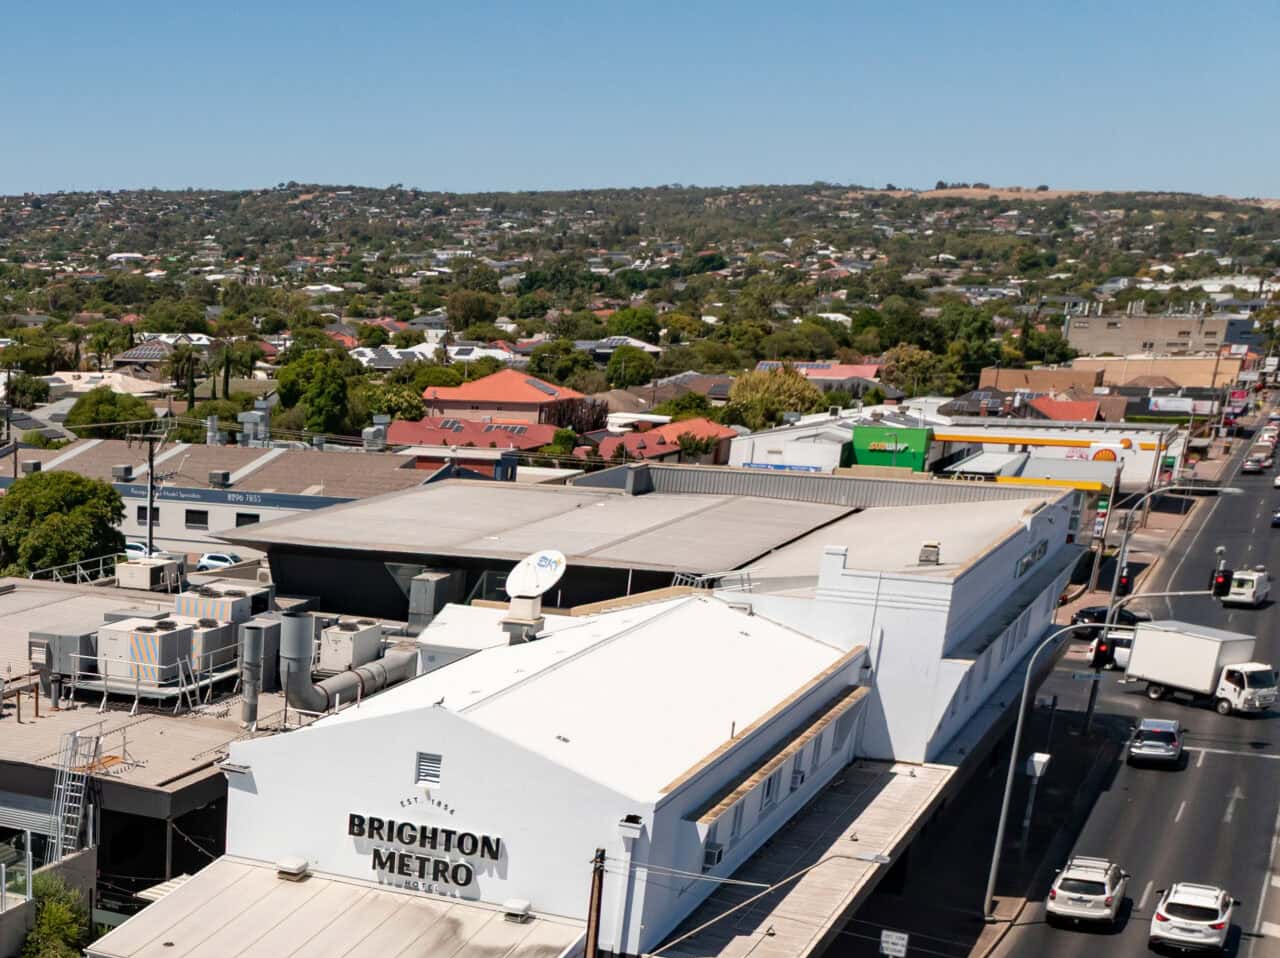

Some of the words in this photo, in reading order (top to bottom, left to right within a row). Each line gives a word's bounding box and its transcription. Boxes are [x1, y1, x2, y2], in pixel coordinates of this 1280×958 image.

[348, 813, 501, 860] BRIGHTON
[372, 848, 473, 887] METRO
[405, 880, 439, 892] HOTEL
